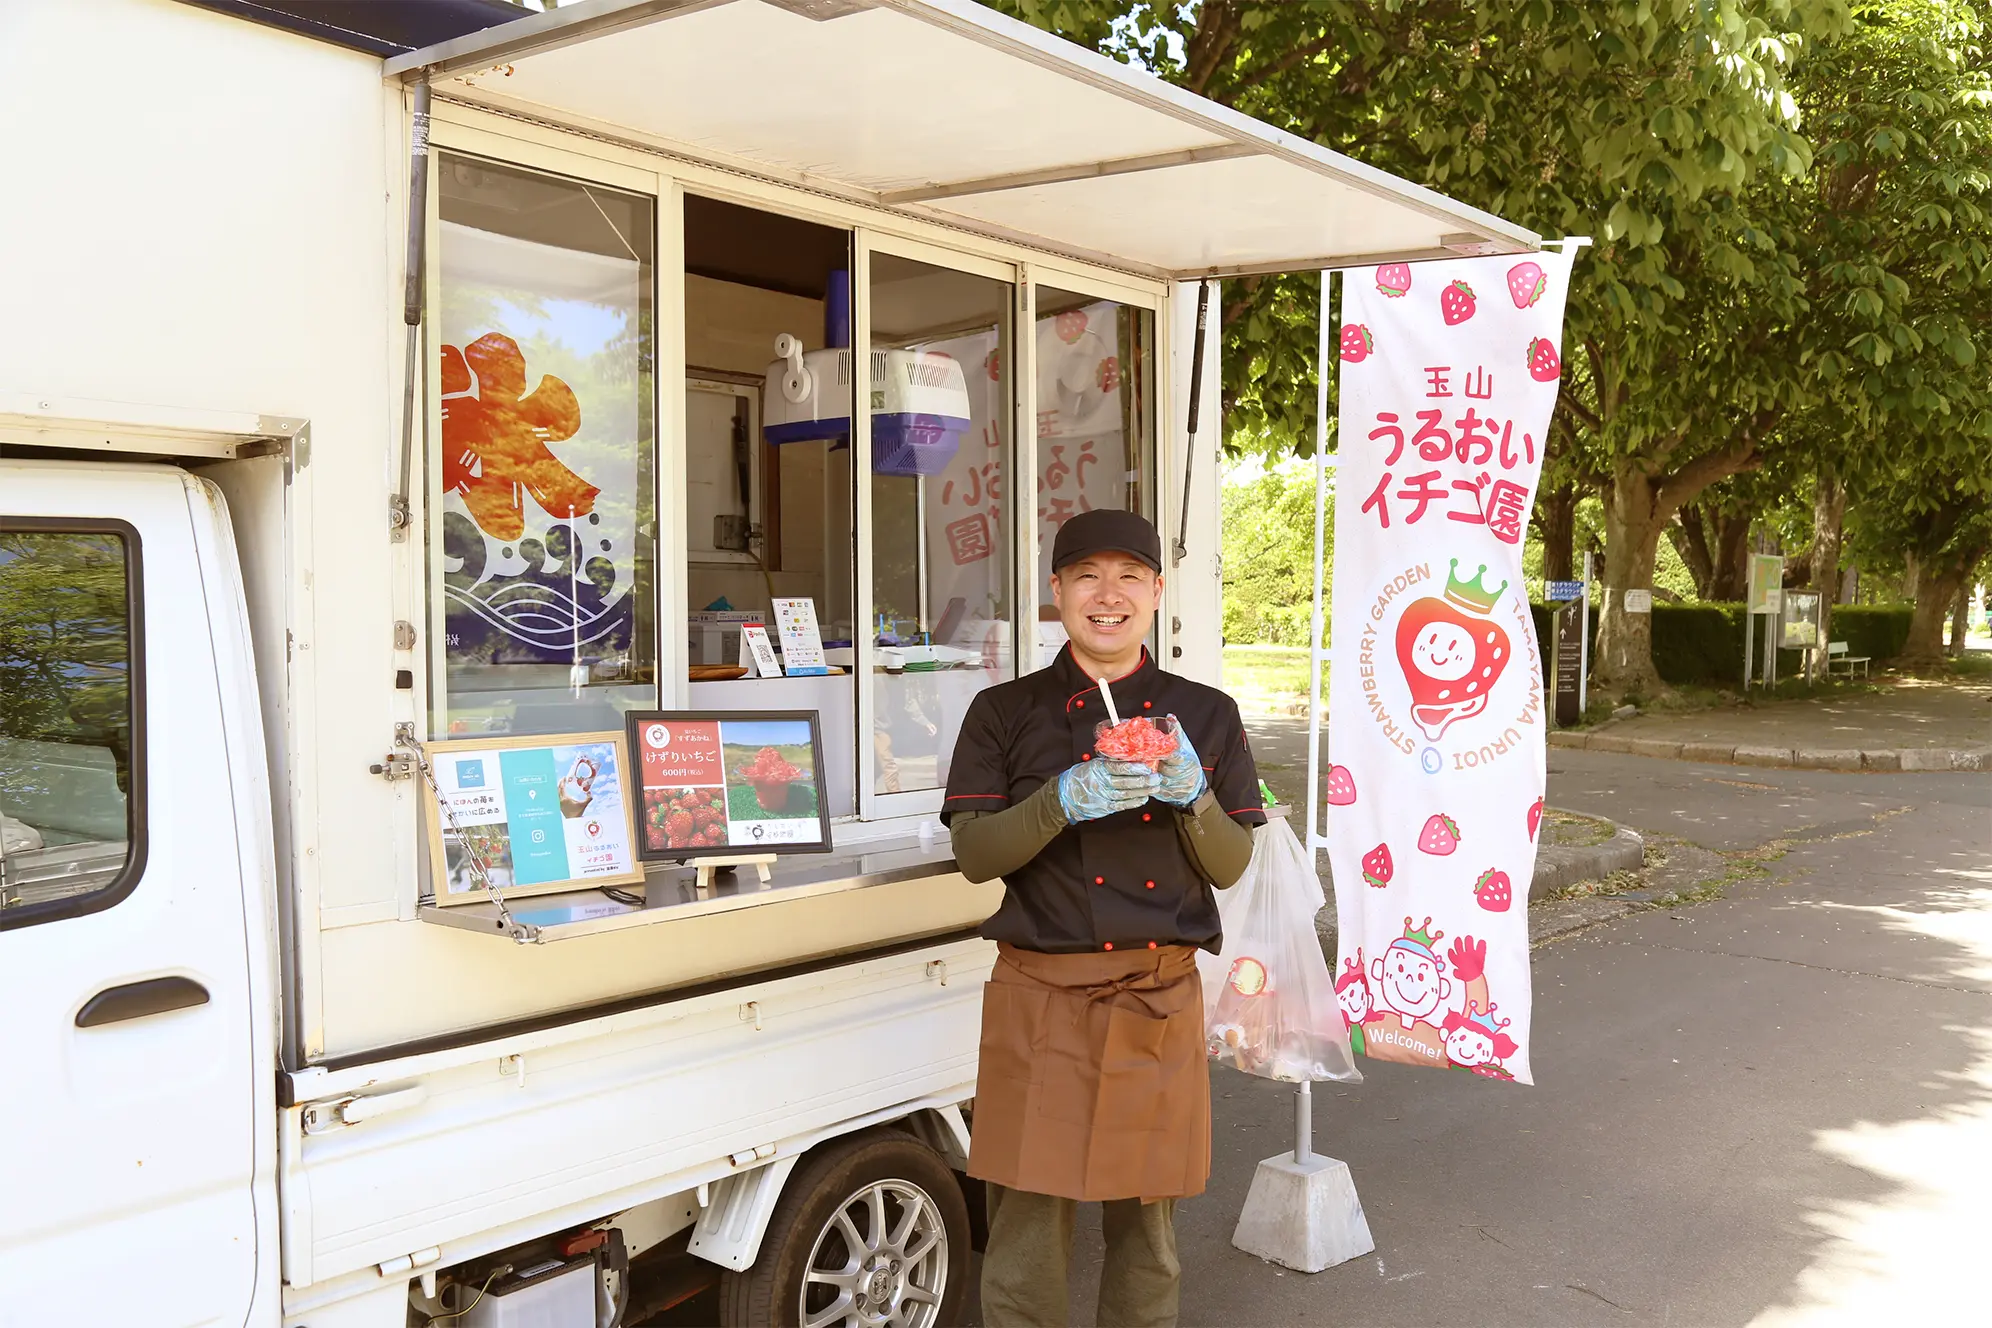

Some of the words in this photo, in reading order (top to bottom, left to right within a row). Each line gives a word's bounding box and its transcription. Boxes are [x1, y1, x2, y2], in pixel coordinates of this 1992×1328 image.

[1424, 366, 1493, 399] 玉山
[1369, 408, 1534, 470] うるおい
[1362, 470, 1529, 544] イチゴ園
[1371, 562, 1431, 621] GARDEN
[1359, 623, 1416, 755] STRAWBERRY
[1512, 597, 1540, 725] TAMAYAMA
[646, 750, 717, 763] けずりいちご
[1453, 727, 1522, 770] URUOI
[1368, 1027, 1442, 1060] Welcome!
